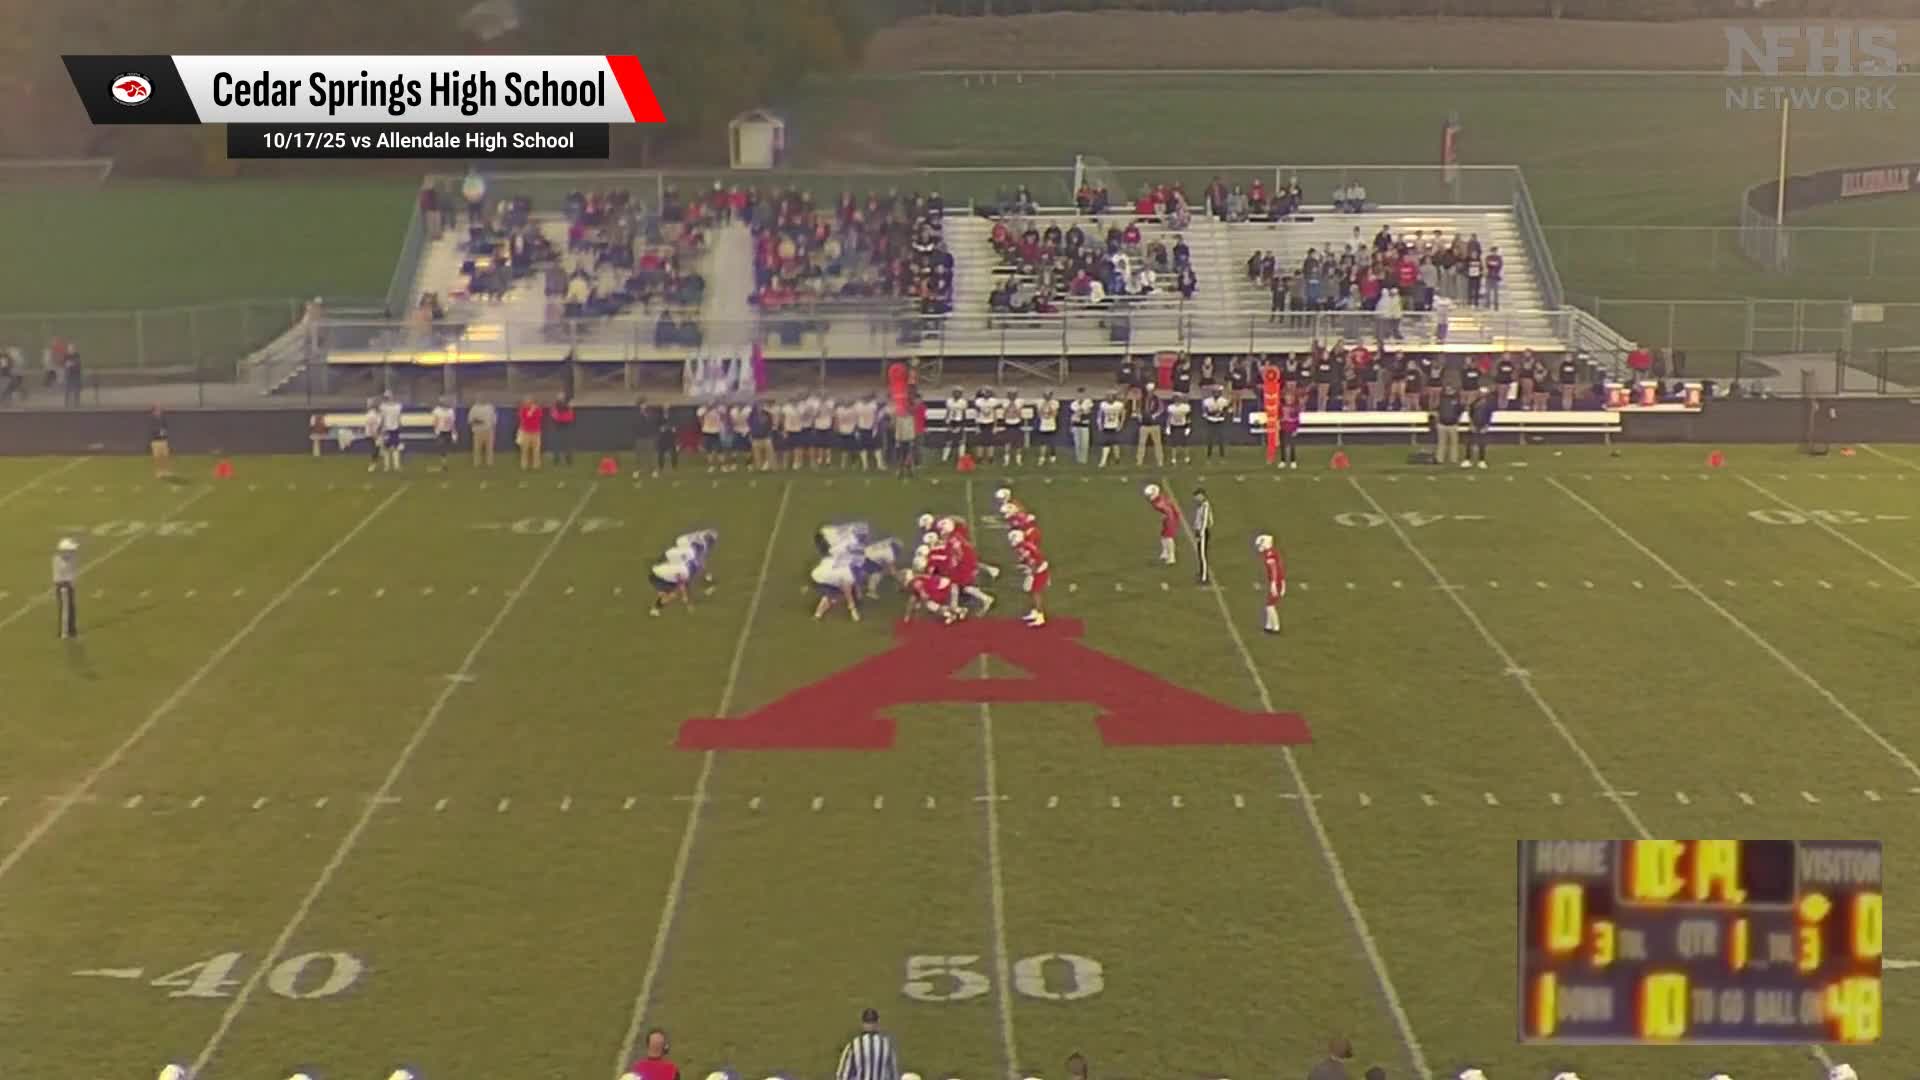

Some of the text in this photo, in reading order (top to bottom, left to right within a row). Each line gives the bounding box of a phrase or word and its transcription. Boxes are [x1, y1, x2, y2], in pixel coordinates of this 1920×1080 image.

[675, 618, 1313, 750] A
[1536, 841, 1607, 874] HOME
[1551, 883, 1583, 949] 0
[151, 952, 363, 999] 40
[903, 953, 1105, 1001] 50
